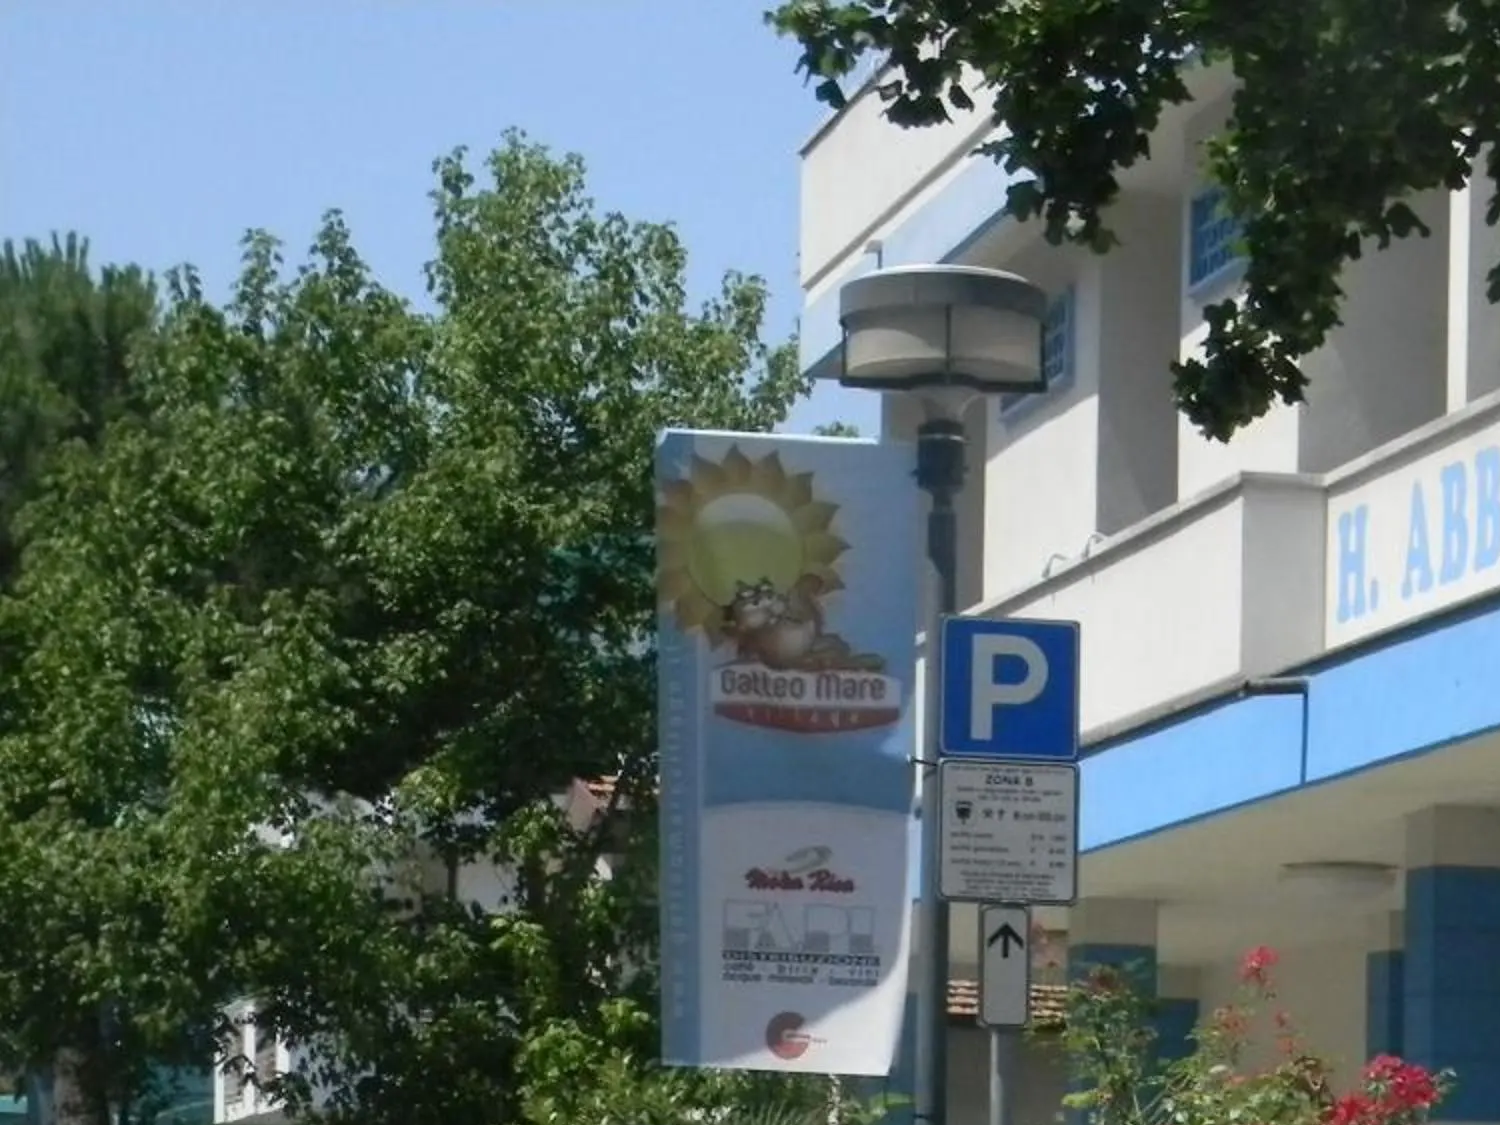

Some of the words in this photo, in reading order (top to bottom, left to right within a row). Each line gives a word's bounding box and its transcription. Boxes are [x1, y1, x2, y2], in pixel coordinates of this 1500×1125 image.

[1338, 503, 1379, 624] H.
[720, 669, 806, 698] Gatteo
[816, 673, 886, 700] Mare
[971, 633, 1049, 740] P
